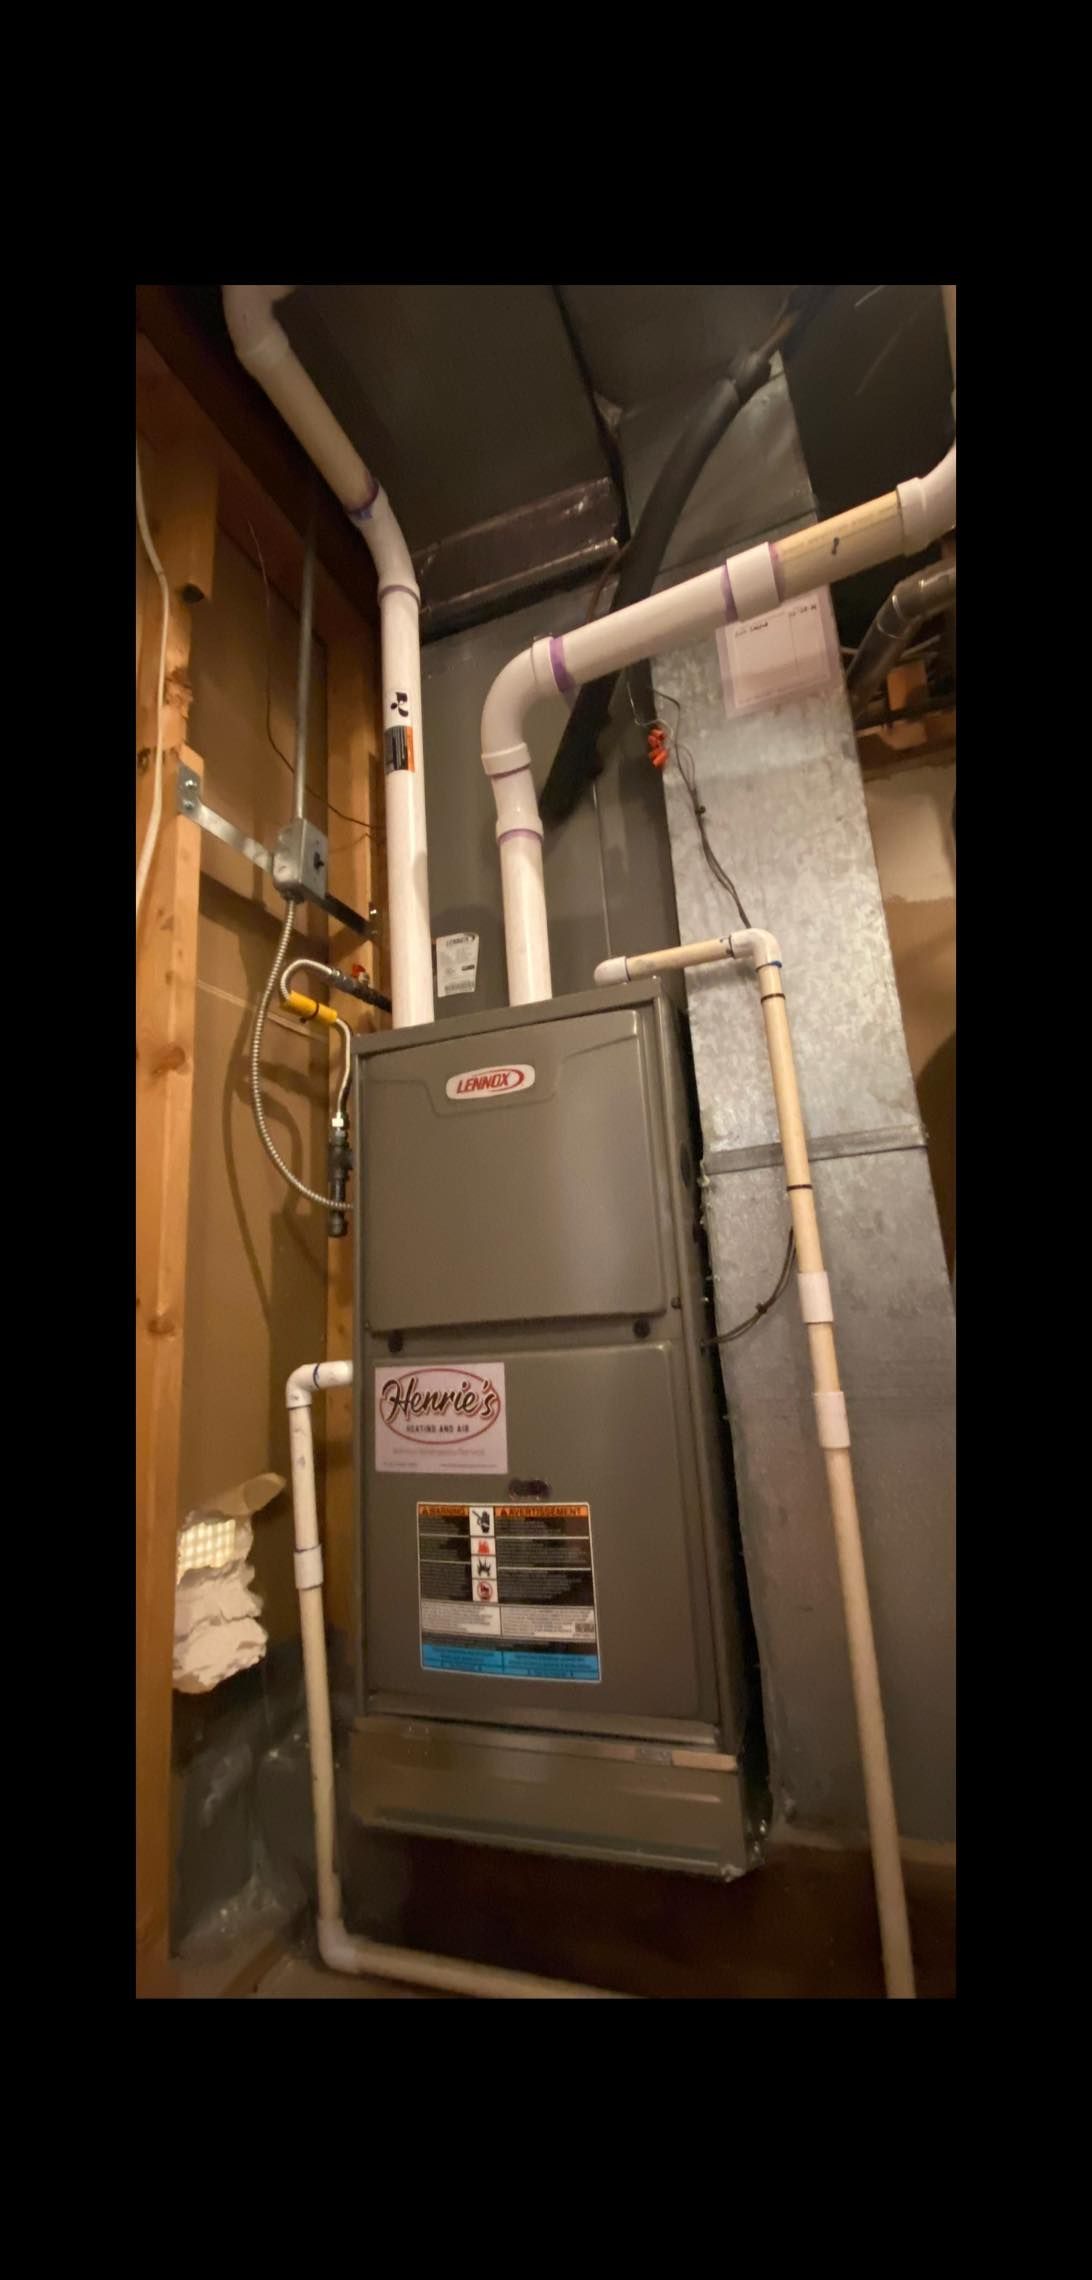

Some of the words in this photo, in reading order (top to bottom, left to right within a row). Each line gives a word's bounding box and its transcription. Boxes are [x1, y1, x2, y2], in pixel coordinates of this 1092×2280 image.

[456, 1073, 510, 1094] LENNOX
[381, 1377, 496, 1422] Henrie's
[439, 1424, 454, 1433] AND
[457, 1424, 470, 1433] AIR
